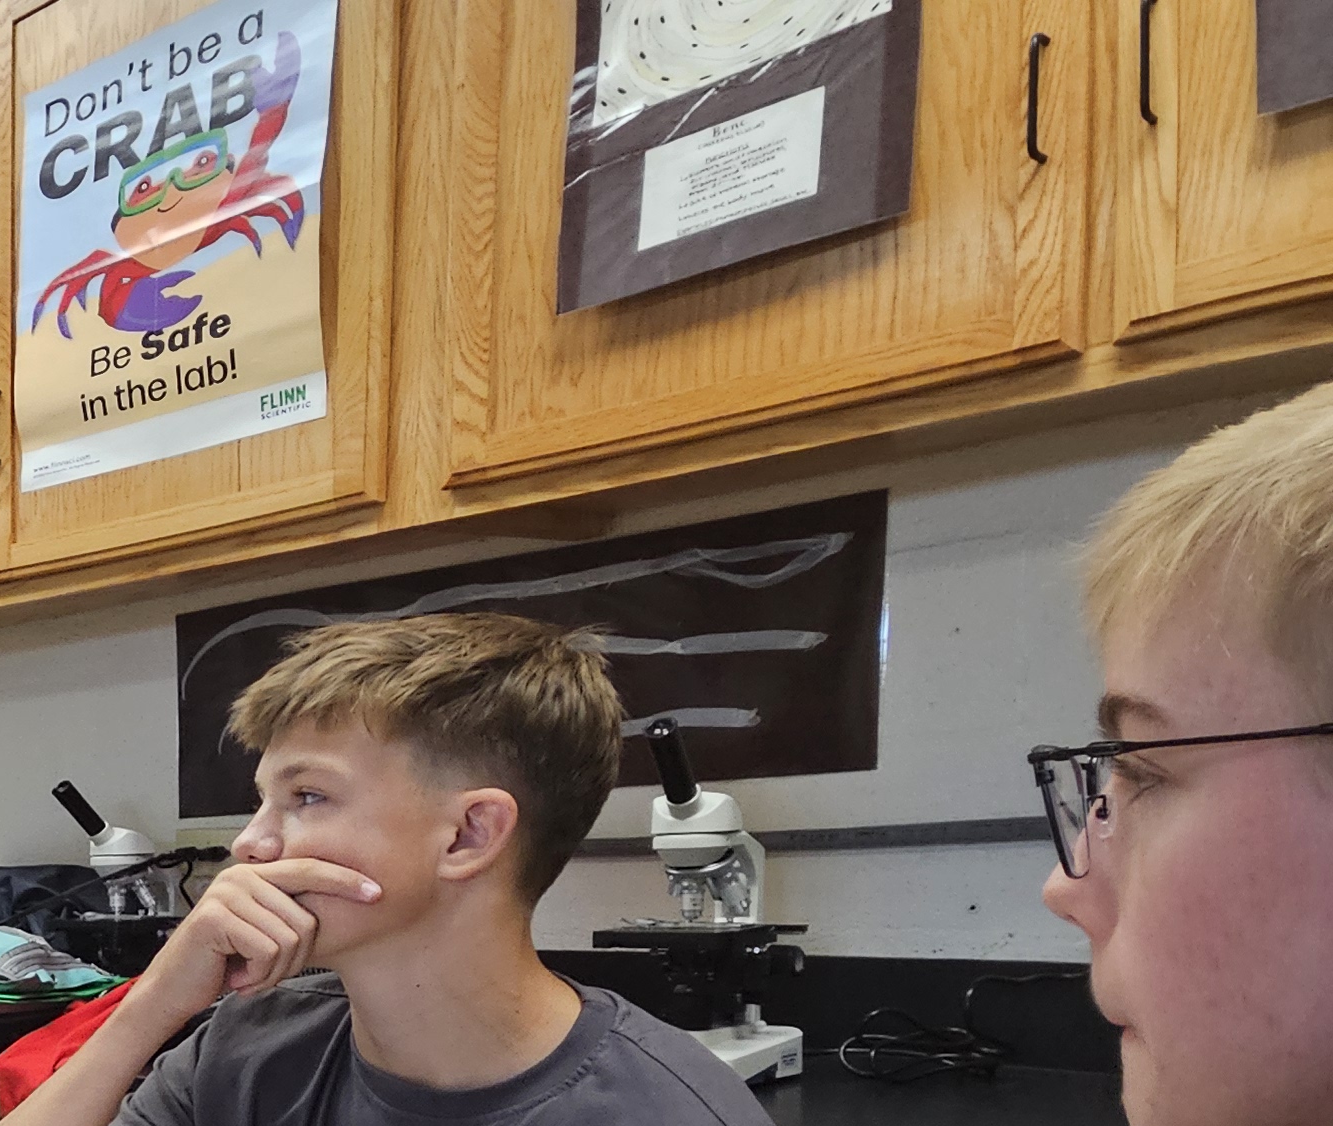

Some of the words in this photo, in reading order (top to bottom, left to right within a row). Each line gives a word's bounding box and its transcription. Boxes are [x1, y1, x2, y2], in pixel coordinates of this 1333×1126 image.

[44, 58, 153, 137] Don't
[169, 32, 221, 80] be
[239, 9, 264, 44] a
[39, 54, 260, 200] CRAB
[90, 346, 131, 377] Be
[140, 311, 231, 361] Safe
[81, 393, 107, 422] in
[116, 375, 167, 411] the
[177, 349, 237, 395] lab!
[260, 384, 307, 411] FLINN
[260, 402, 312, 419] SCIENTIFIC
